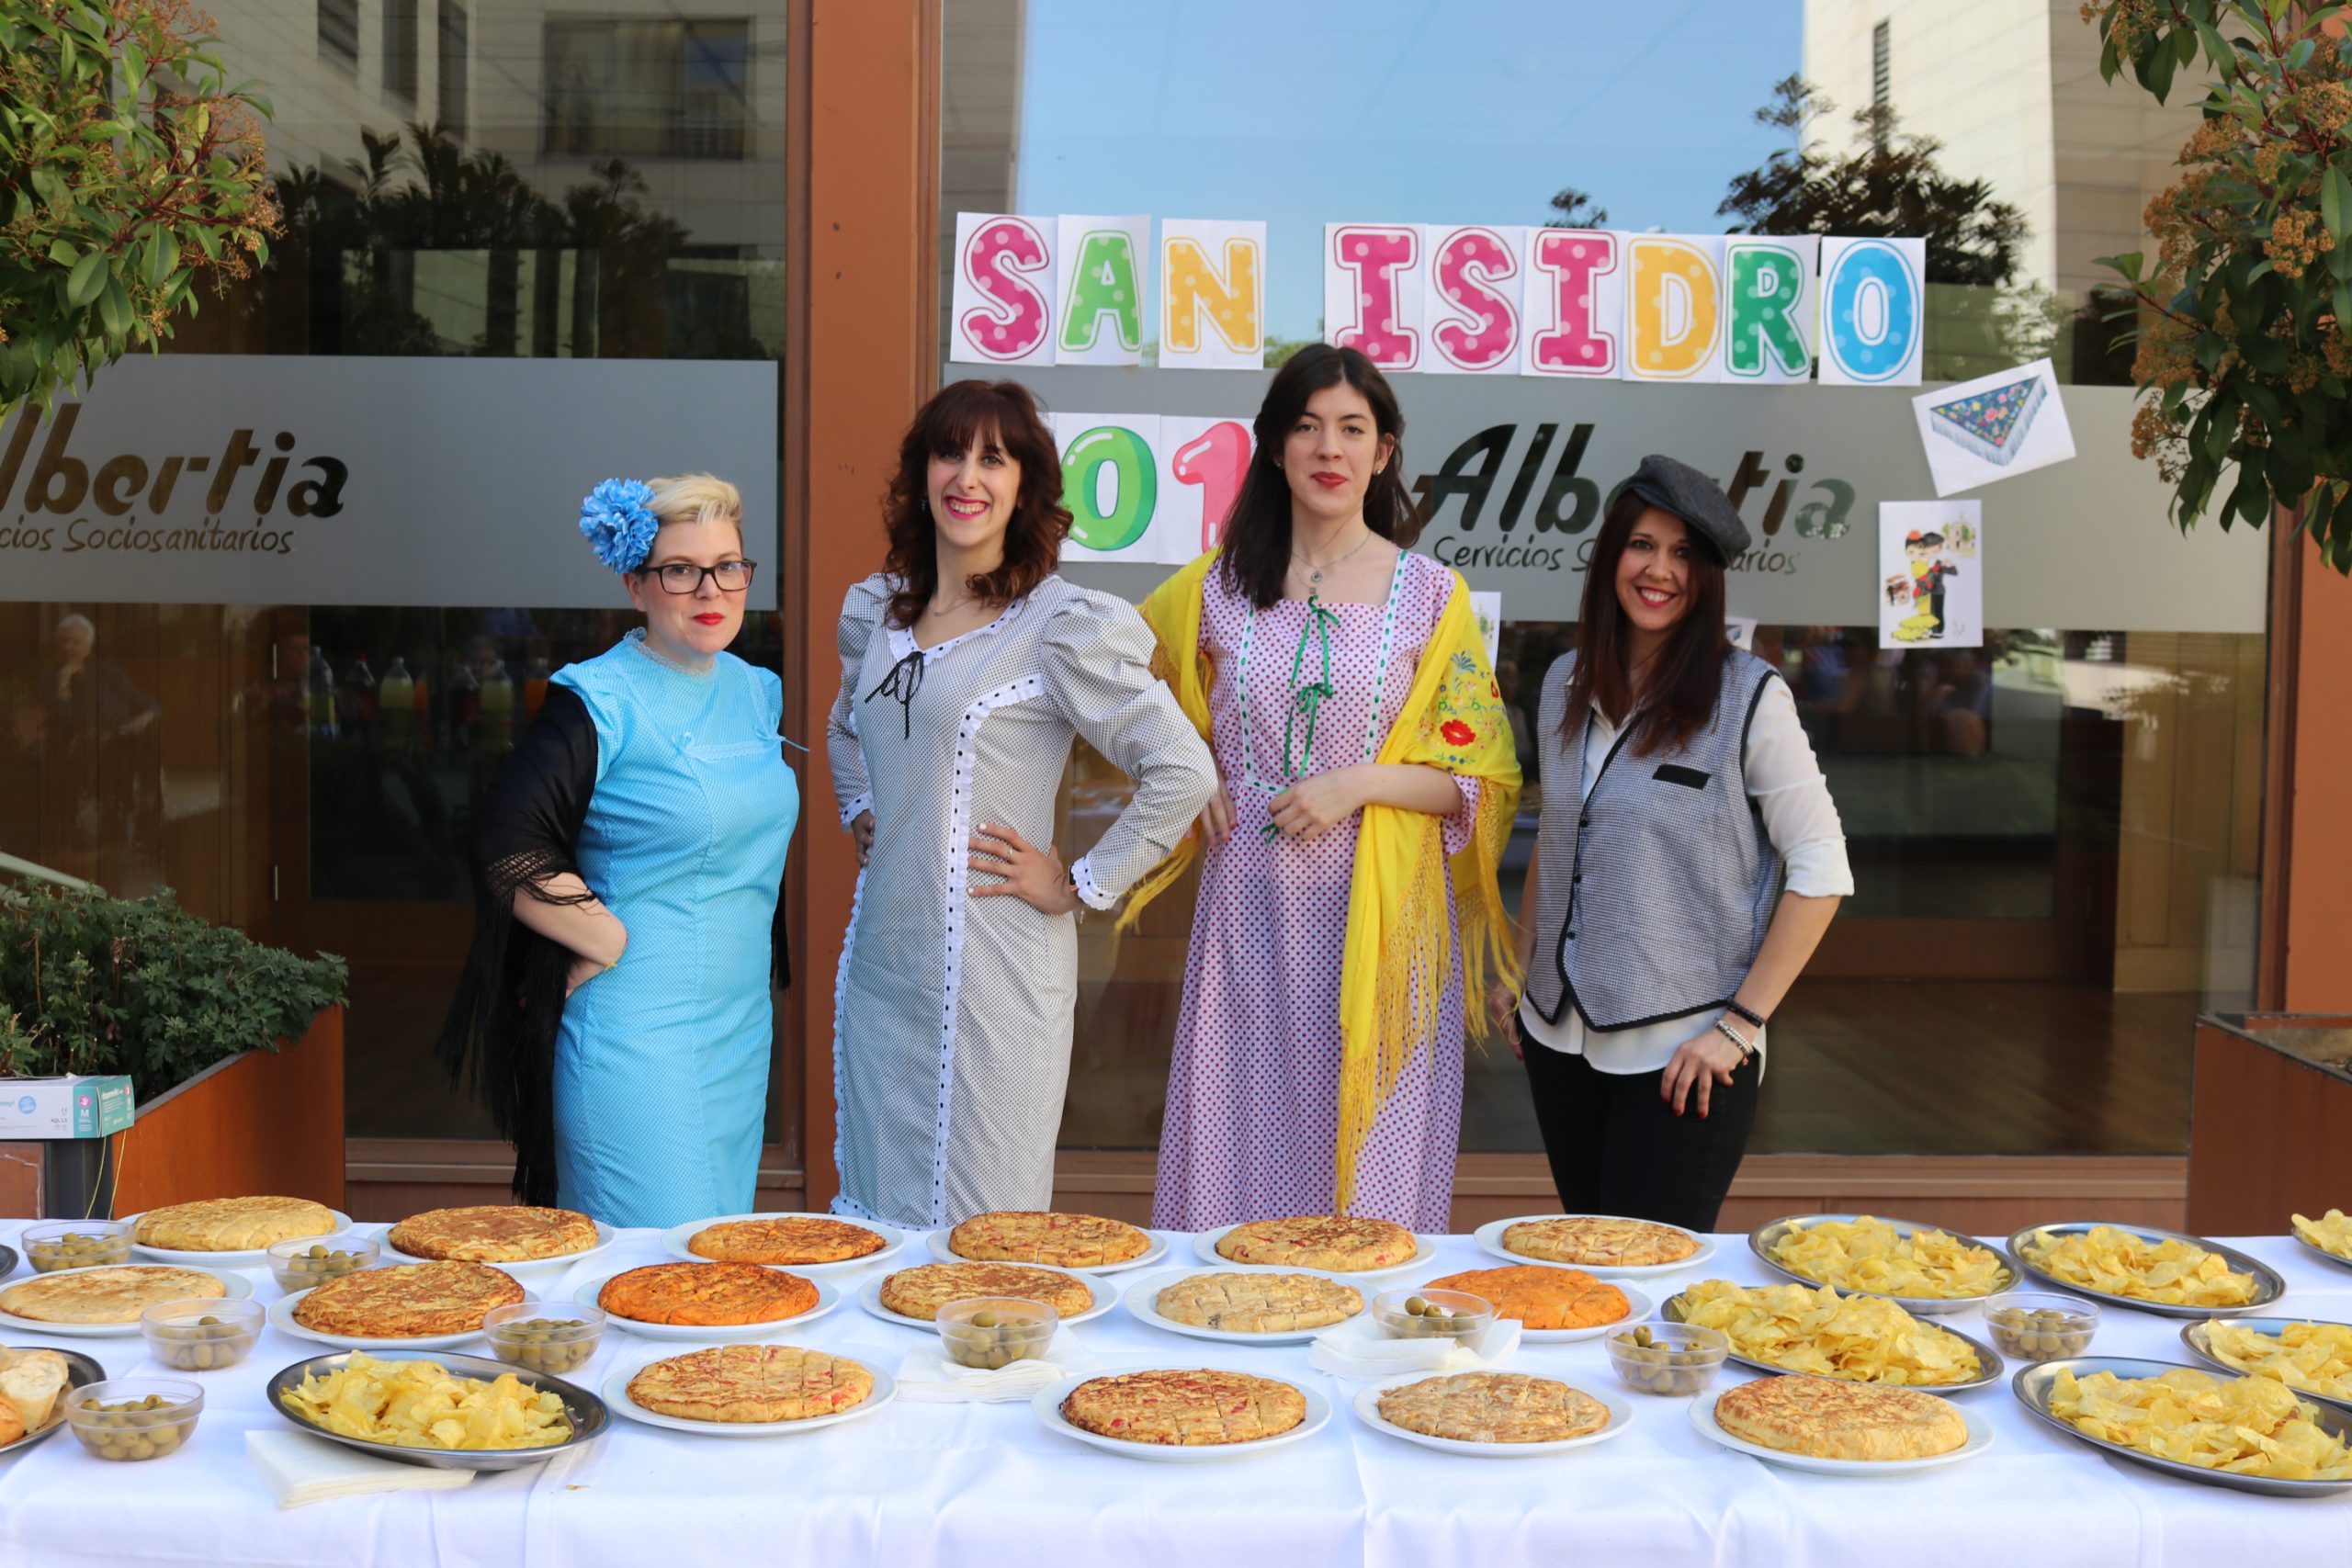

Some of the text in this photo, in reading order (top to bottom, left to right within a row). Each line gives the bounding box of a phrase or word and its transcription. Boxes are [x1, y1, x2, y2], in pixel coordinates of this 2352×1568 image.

[960, 216, 1922, 383] SAN ISIDRO
[0, 402, 348, 518] lbertia
[1061, 421, 1251, 551] 01
[1411, 423, 1856, 539] Albtia
[0, 514, 294, 554] cios Sociosanitarios
[1433, 534, 1561, 571] Servicios
[80, 1109, 90, 1118] M
